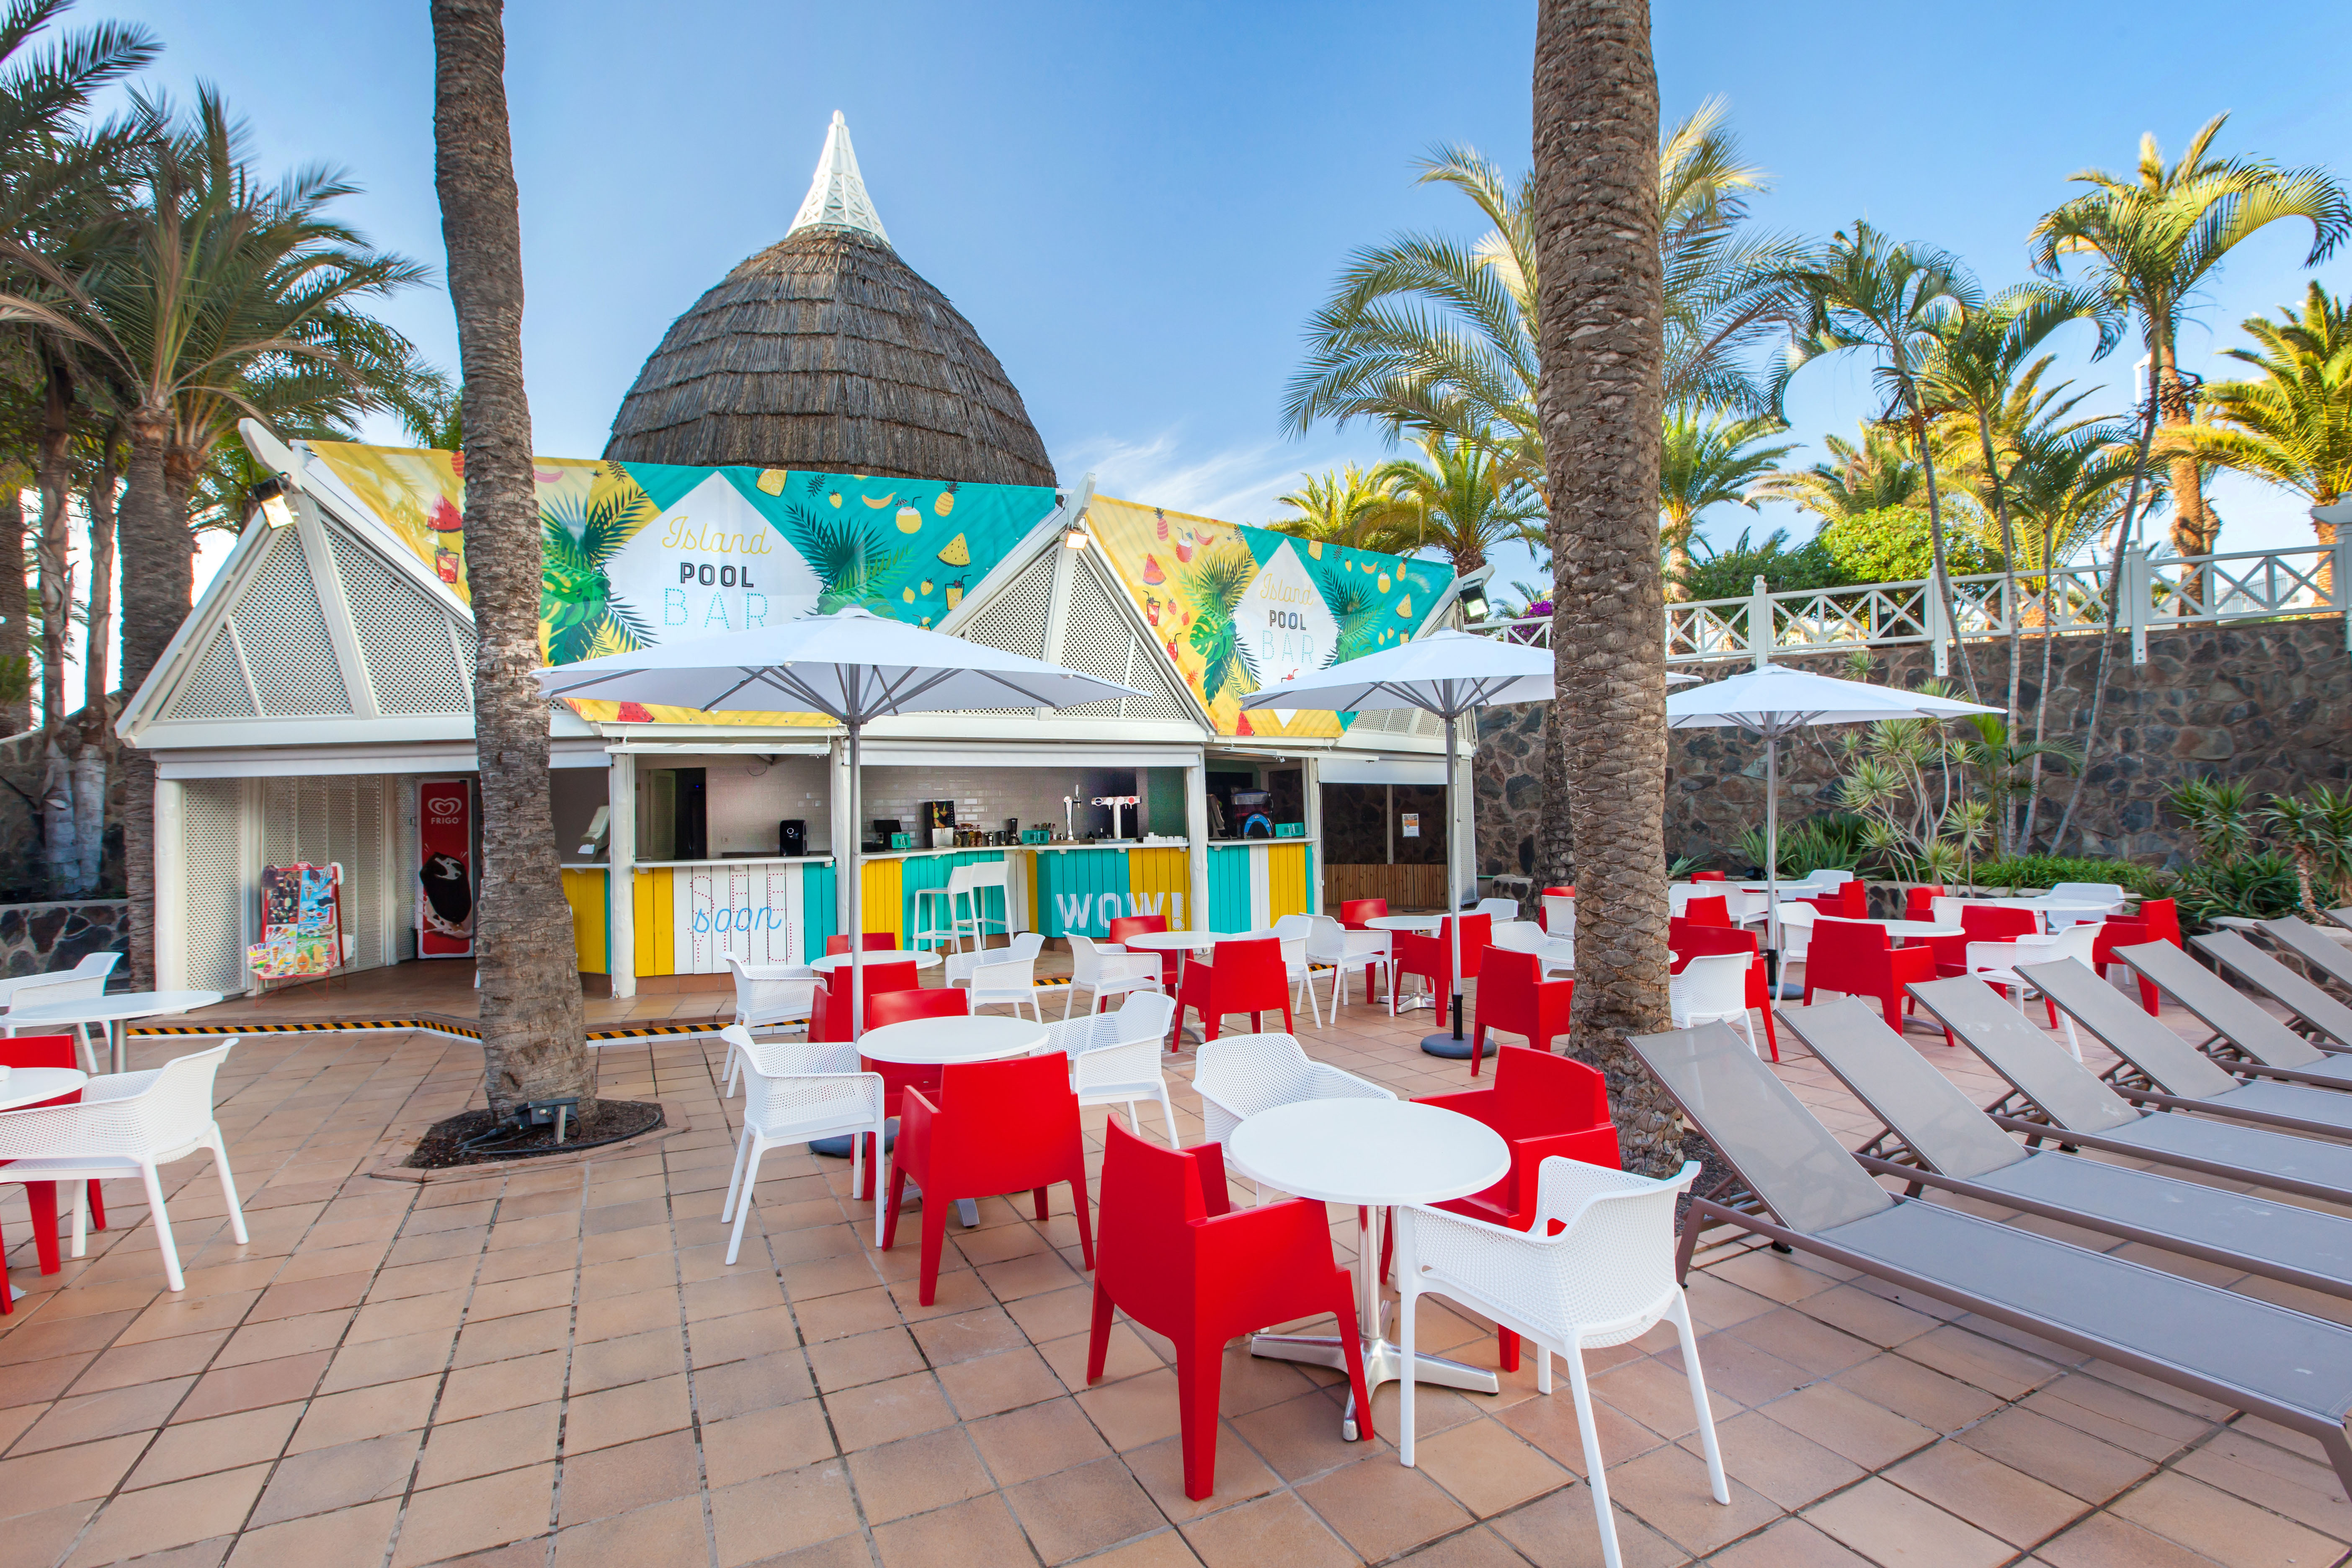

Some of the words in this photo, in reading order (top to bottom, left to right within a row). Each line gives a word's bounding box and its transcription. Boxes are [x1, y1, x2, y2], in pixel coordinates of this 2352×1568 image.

[662, 516, 772, 554] Island
[680, 562, 754, 588] POOL
[1260, 573, 1314, 606] Island
[665, 588, 768, 629] BAR
[1269, 610, 1307, 631] POOL
[1262, 630, 1314, 664] BAR
[689, 873, 787, 915] SEE
[693, 907, 782, 933] soon
[1055, 892, 1184, 931] WOW!
